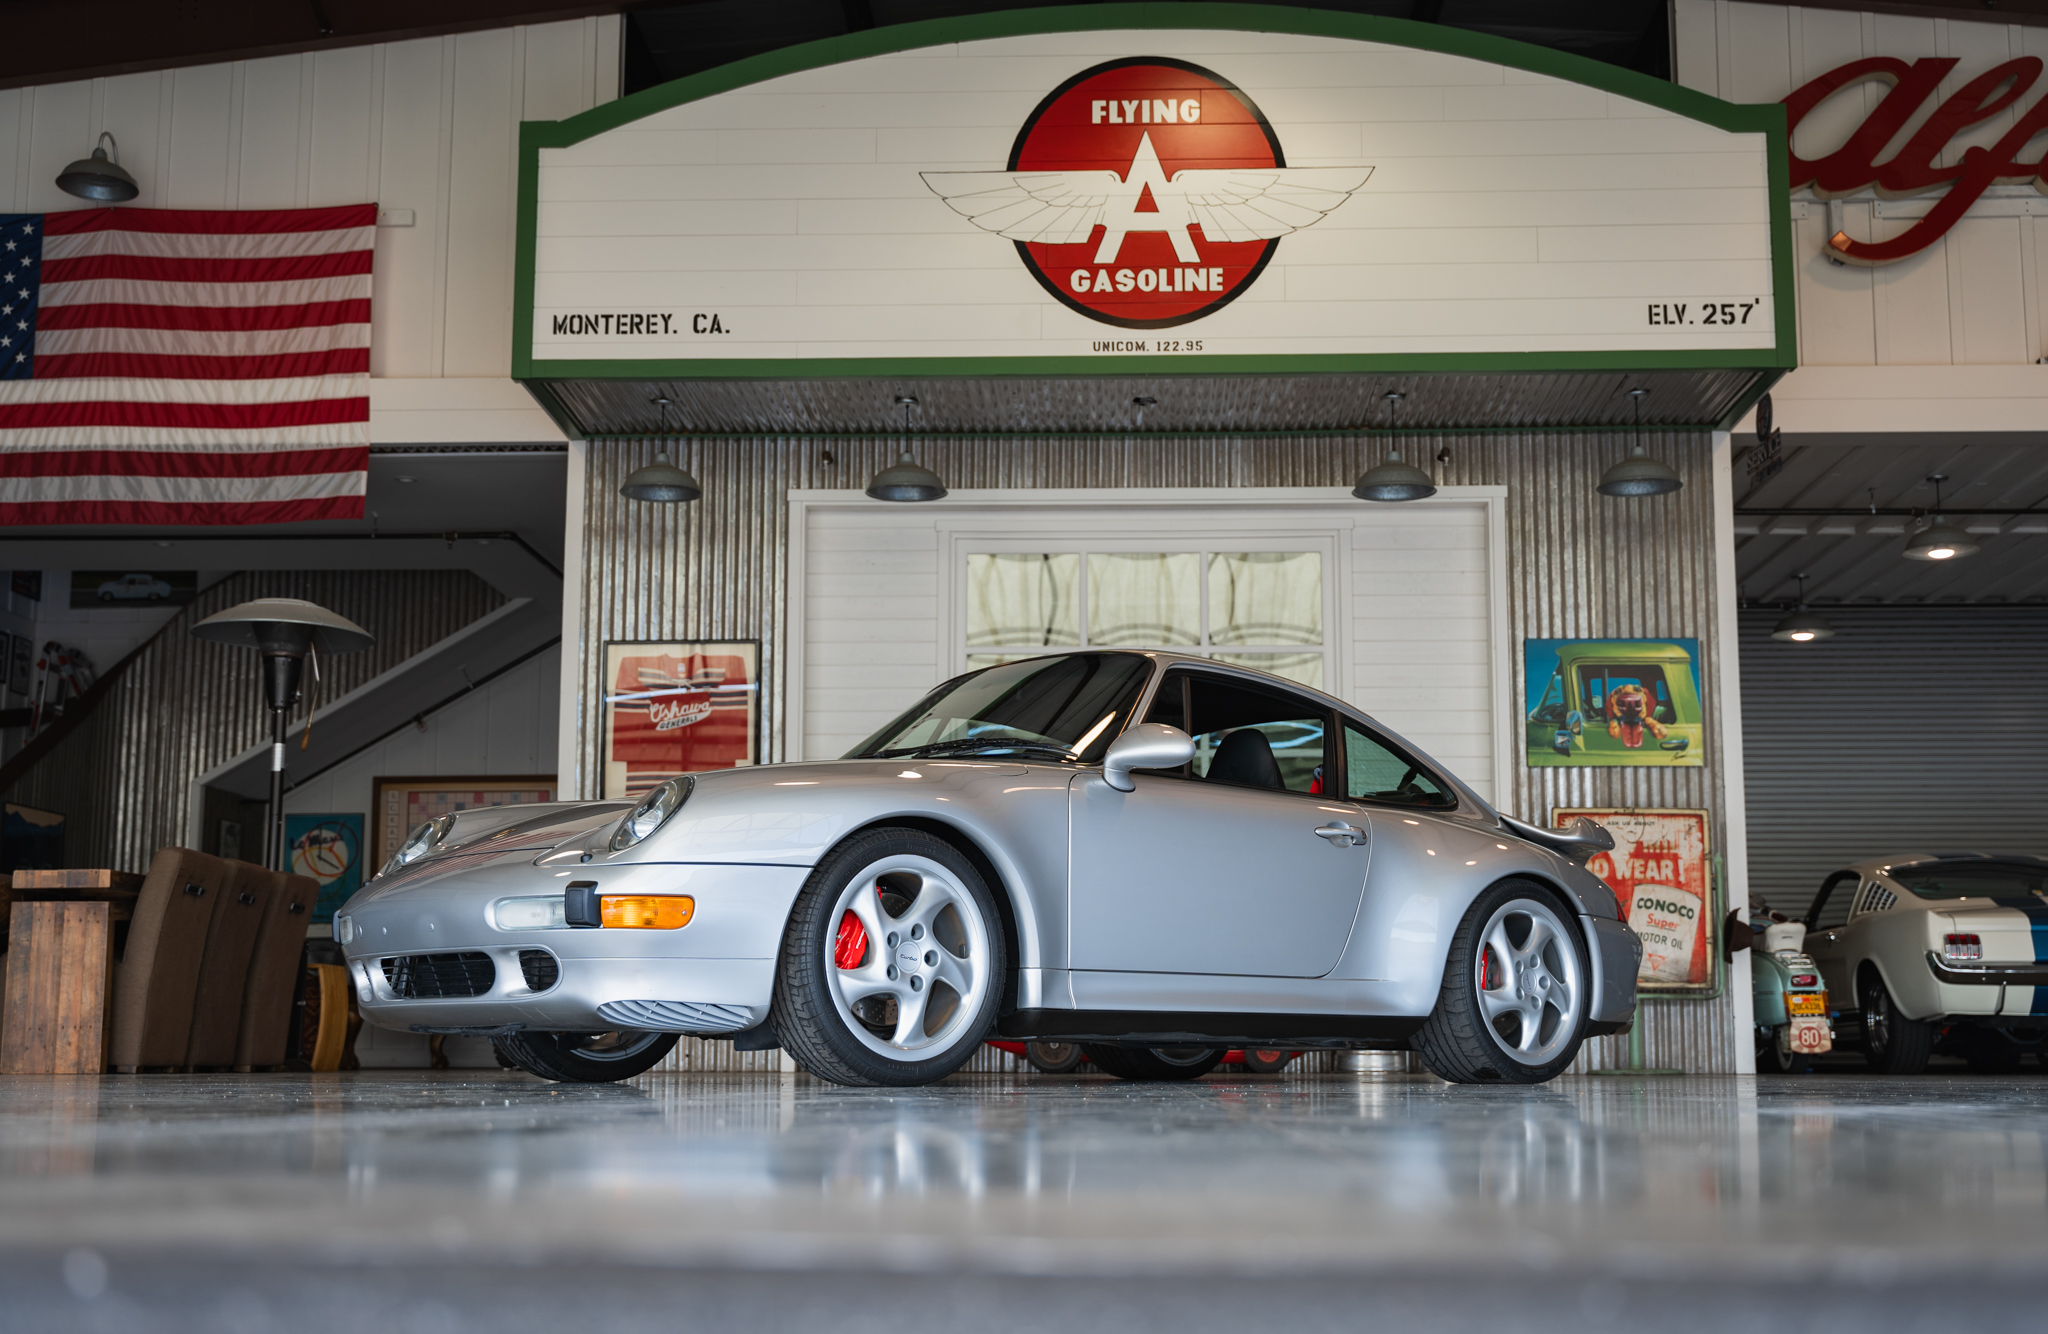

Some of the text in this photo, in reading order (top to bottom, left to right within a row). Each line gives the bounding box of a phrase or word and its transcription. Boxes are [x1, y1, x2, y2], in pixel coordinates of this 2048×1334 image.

[1092, 99, 1201, 124] FLYING
[1779, 56, 2048, 262] Alf
[1070, 268, 1223, 293] GASOLINE
[553, 313, 730, 335] MONTEREY. CA.
[1648, 303, 1694, 325] ELV.
[1093, 340, 1203, 352] UNICOM. 122.95
[650, 700, 710, 723] Oshawa
[660, 715, 698, 729] GENERALS
[1612, 857, 1686, 884] WEAR!
[1637, 897, 1695, 920] CONOCO
[1646, 912, 1680, 931] Super
[1671, 937, 1683, 951] OIL
[1801, 1028, 1819, 1046] 80
